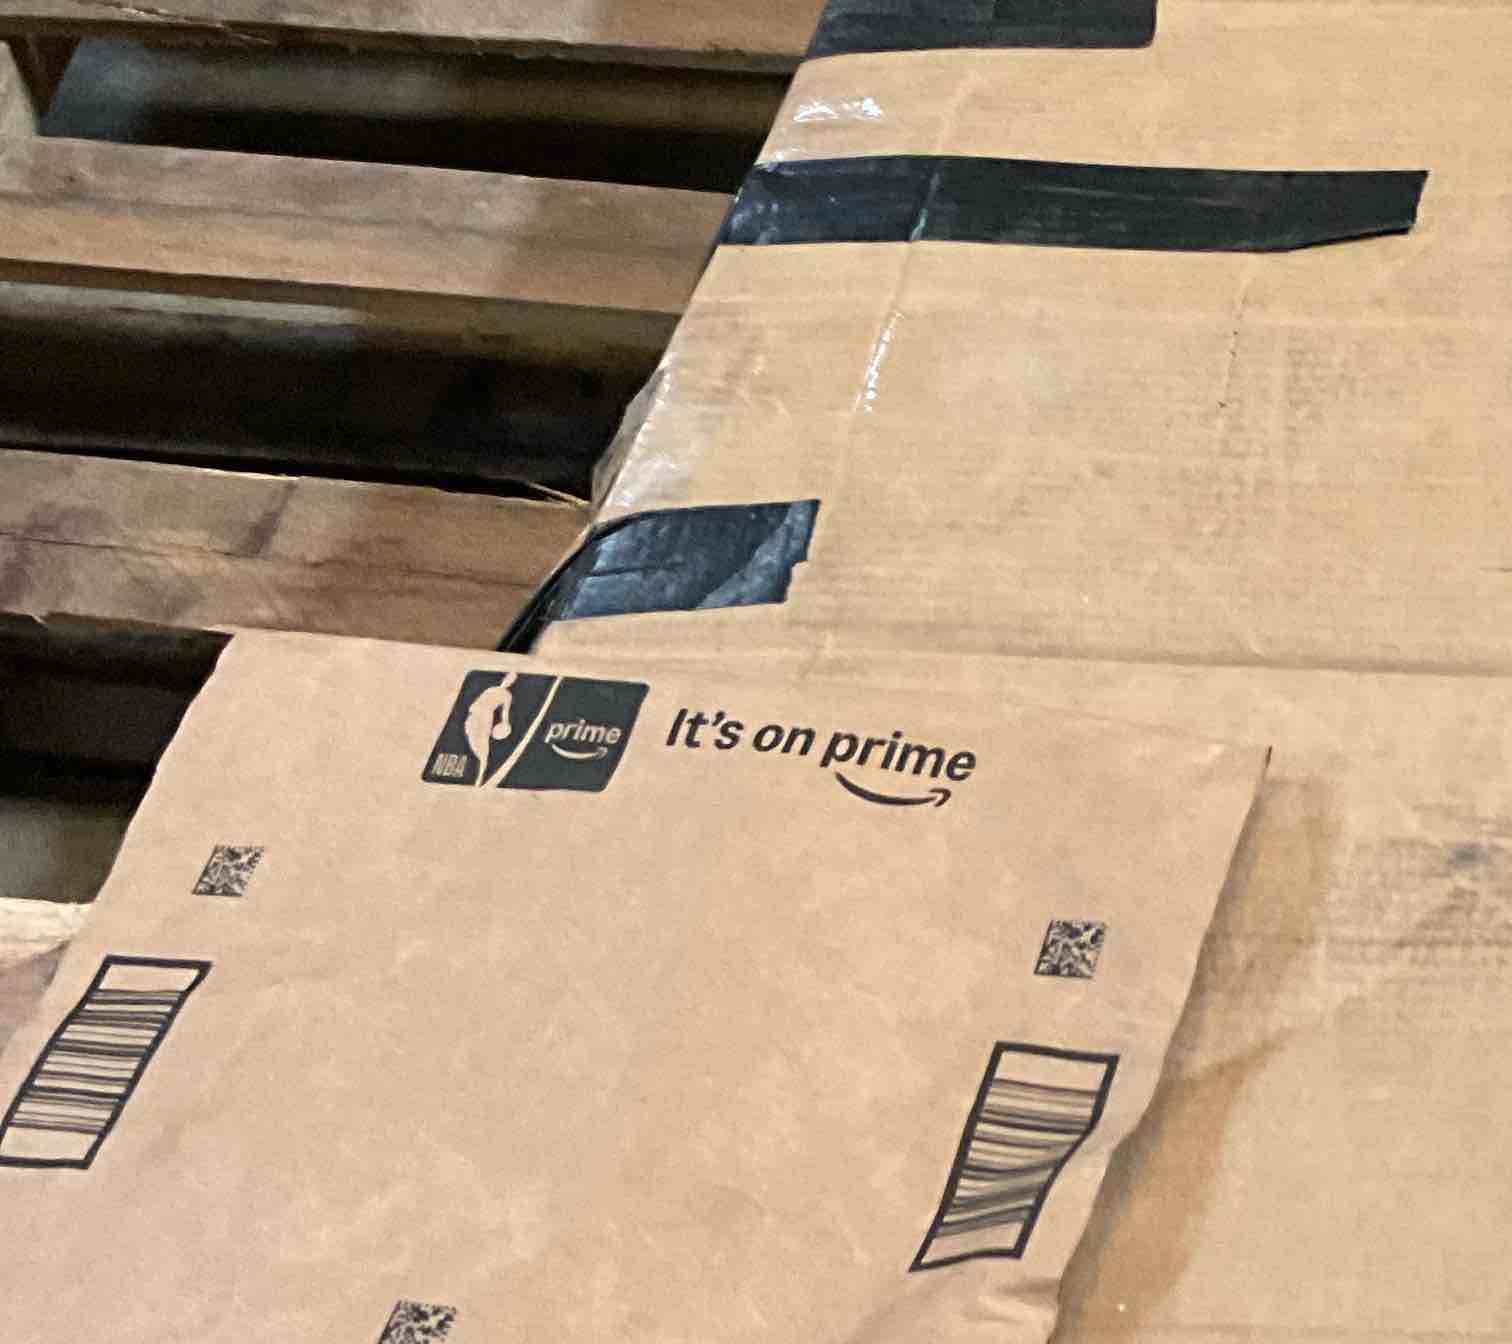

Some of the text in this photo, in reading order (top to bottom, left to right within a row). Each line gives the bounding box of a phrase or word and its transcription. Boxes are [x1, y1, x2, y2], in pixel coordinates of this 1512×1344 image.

[543, 718, 623, 745] prime
[751, 720, 818, 757] on
[818, 727, 978, 782] prime
[430, 752, 469, 779] NBA
